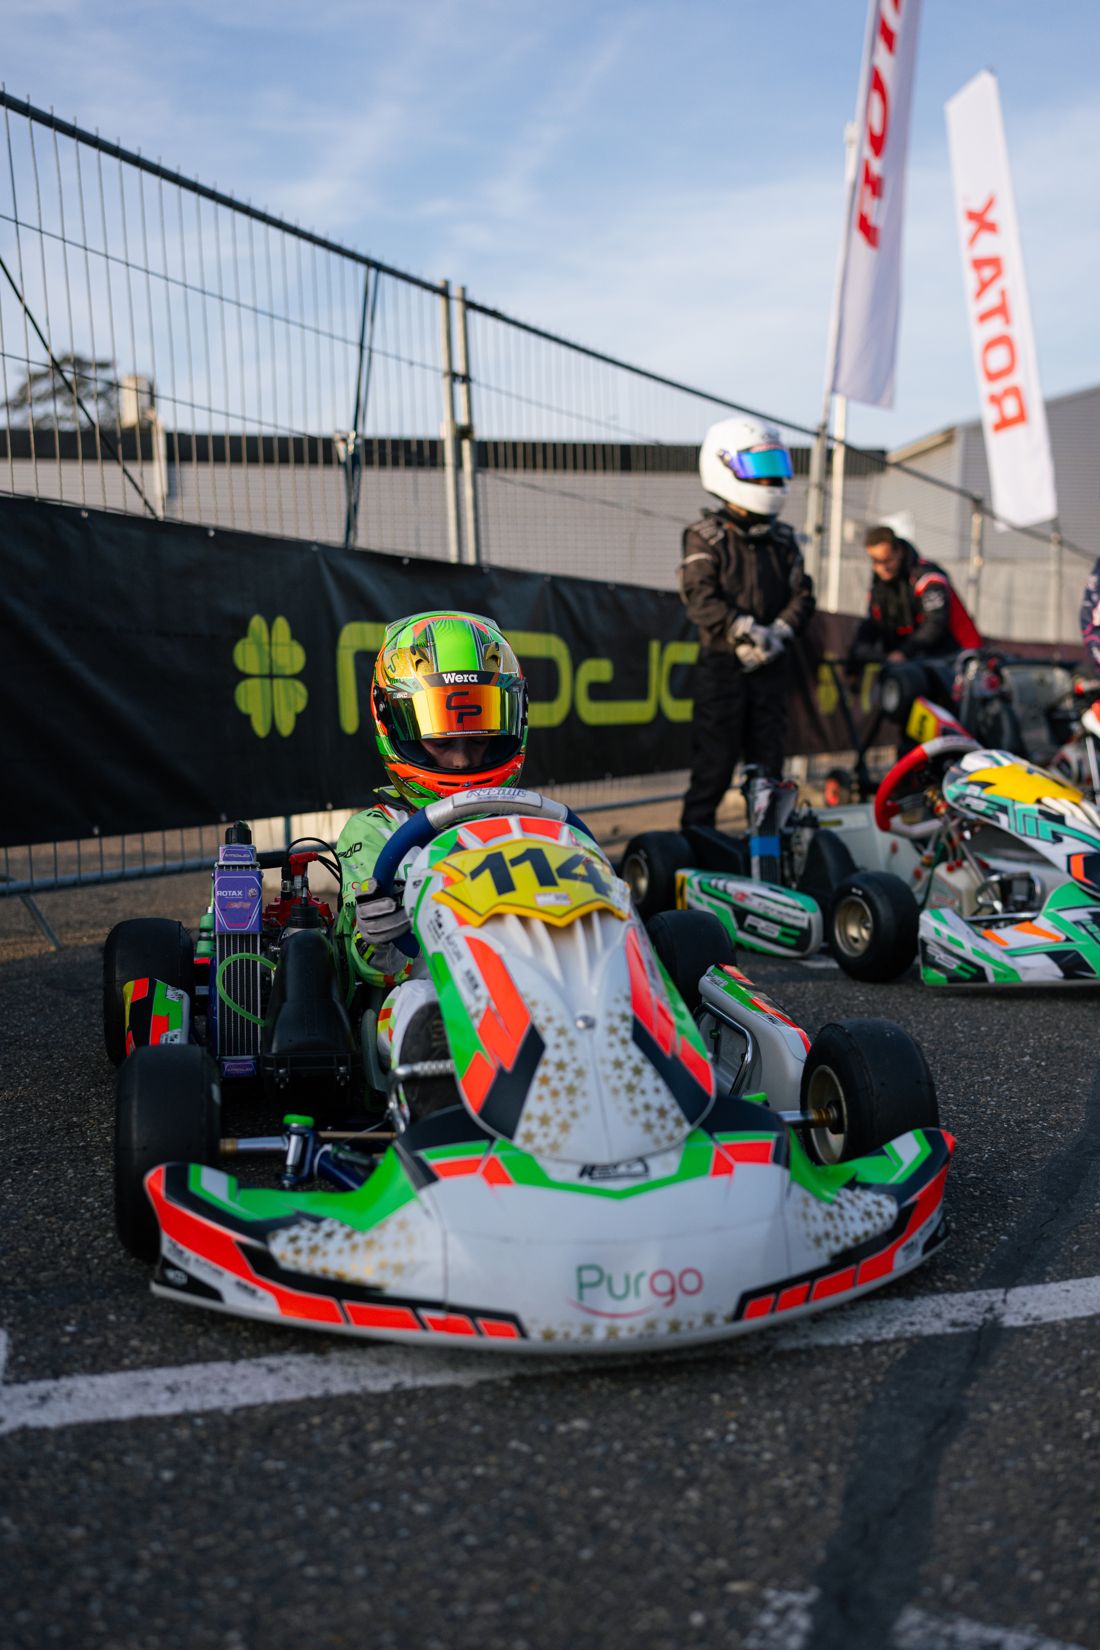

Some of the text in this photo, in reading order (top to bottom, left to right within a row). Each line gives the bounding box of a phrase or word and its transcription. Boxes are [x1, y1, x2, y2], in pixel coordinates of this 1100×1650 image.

[441, 672, 479, 684] Wera
[469, 847, 613, 897] 114
[576, 1263, 705, 1307] Purgo
